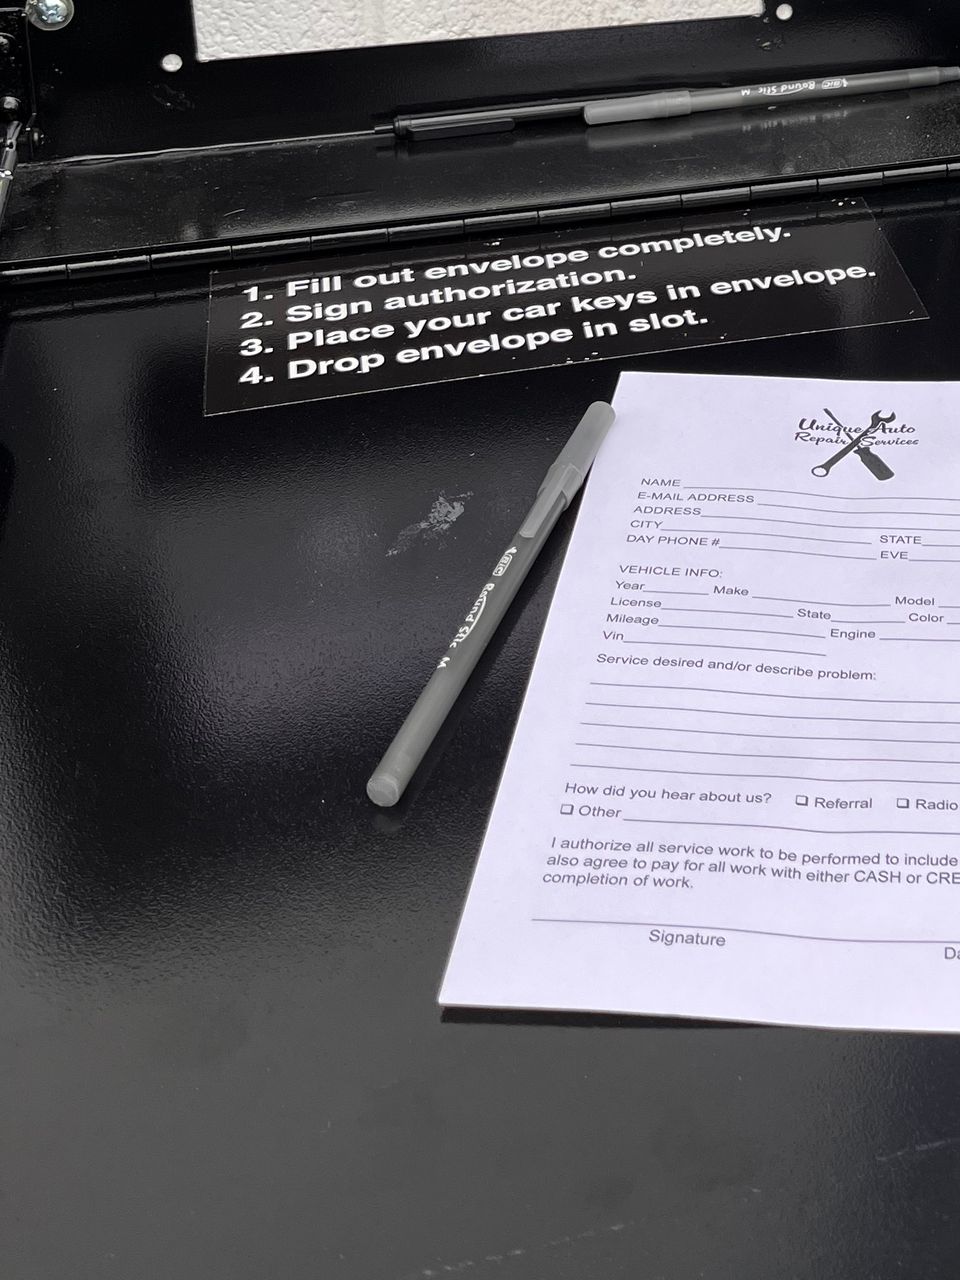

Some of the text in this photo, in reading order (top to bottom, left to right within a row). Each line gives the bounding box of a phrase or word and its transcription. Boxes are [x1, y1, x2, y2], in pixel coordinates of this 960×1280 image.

[243, 225, 792, 302] 1. Fill out envelope completely.
[239, 265, 876, 357] 3. Place your car keys in envelope.
[240, 268, 637, 329] 2. Sign authorization.
[238, 309, 708, 385] 4. Drop envelope in slot.
[794, 431, 920, 447] Repair Services
[798, 418, 916, 436] Unique Auto
[641, 478, 681, 487] NAME
[637, 492, 755, 503] E-MAIL ADDRESS
[633, 506, 702, 516] ADDRESS
[630, 520, 663, 529] CITY
[879, 535, 922, 545] STATE
[626, 535, 909, 560] DAY PHONE # EVE
[619, 565, 723, 578] VEHICLE INFO:
[465, 583, 495, 622] Round
[615, 580, 935, 606] Year Make Model
[610, 597, 944, 623] License State Color
[603, 631, 624, 641] Vin
[606, 614, 876, 640] Mileage Engine
[596, 653, 876, 681] Service desired and/or describe problem:
[564, 783, 959, 811] How did you hear about us? Referral Radio
[578, 805, 622, 818] Other
[551, 837, 556, 849] I
[560, 838, 632, 852] authorize
[636, 841, 653, 852] all
[658, 842, 713, 855] service
[718, 846, 754, 858] work
[760, 847, 774, 859] to
[778, 849, 797, 861] be
[802, 852, 880, 866] performed
[885, 854, 899, 865] to
[904, 853, 958, 867] include
[542, 873, 694, 889] completion of work.
[546, 855, 579, 867] also
[583, 858, 628, 870] agree
[633, 858, 647, 869] to
[651, 861, 679, 873] pay
[684, 859, 704, 871] for
[708, 861, 726, 873] all
[730, 863, 766, 876] work
[771, 866, 801, 880] with
[806, 869, 850, 882] either
[854, 870, 901, 884] CASH
[906, 873, 922, 884] or
[649, 929, 726, 947] Signature
